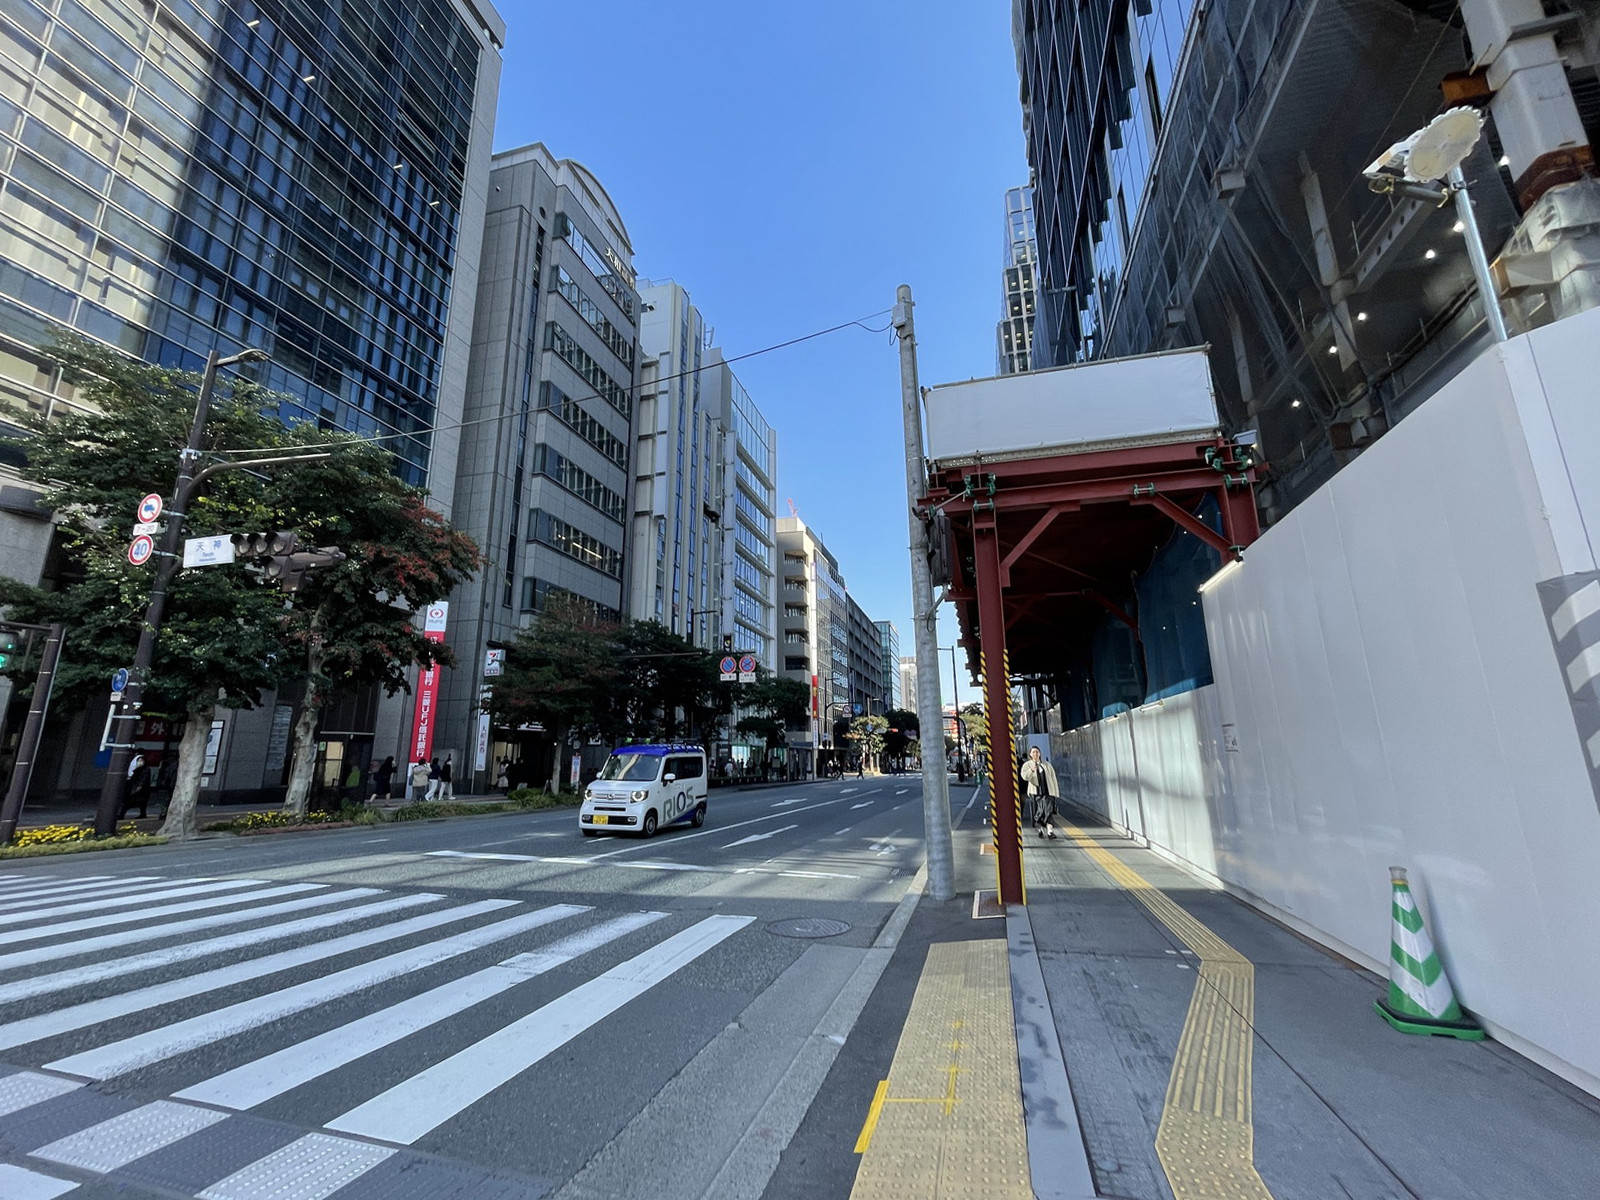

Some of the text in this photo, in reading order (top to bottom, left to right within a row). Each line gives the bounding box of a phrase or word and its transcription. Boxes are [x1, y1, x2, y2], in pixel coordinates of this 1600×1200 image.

[134, 543, 148, 556] 40
[196, 539, 222, 552] 天神
[662, 786, 694, 822] RIOS
